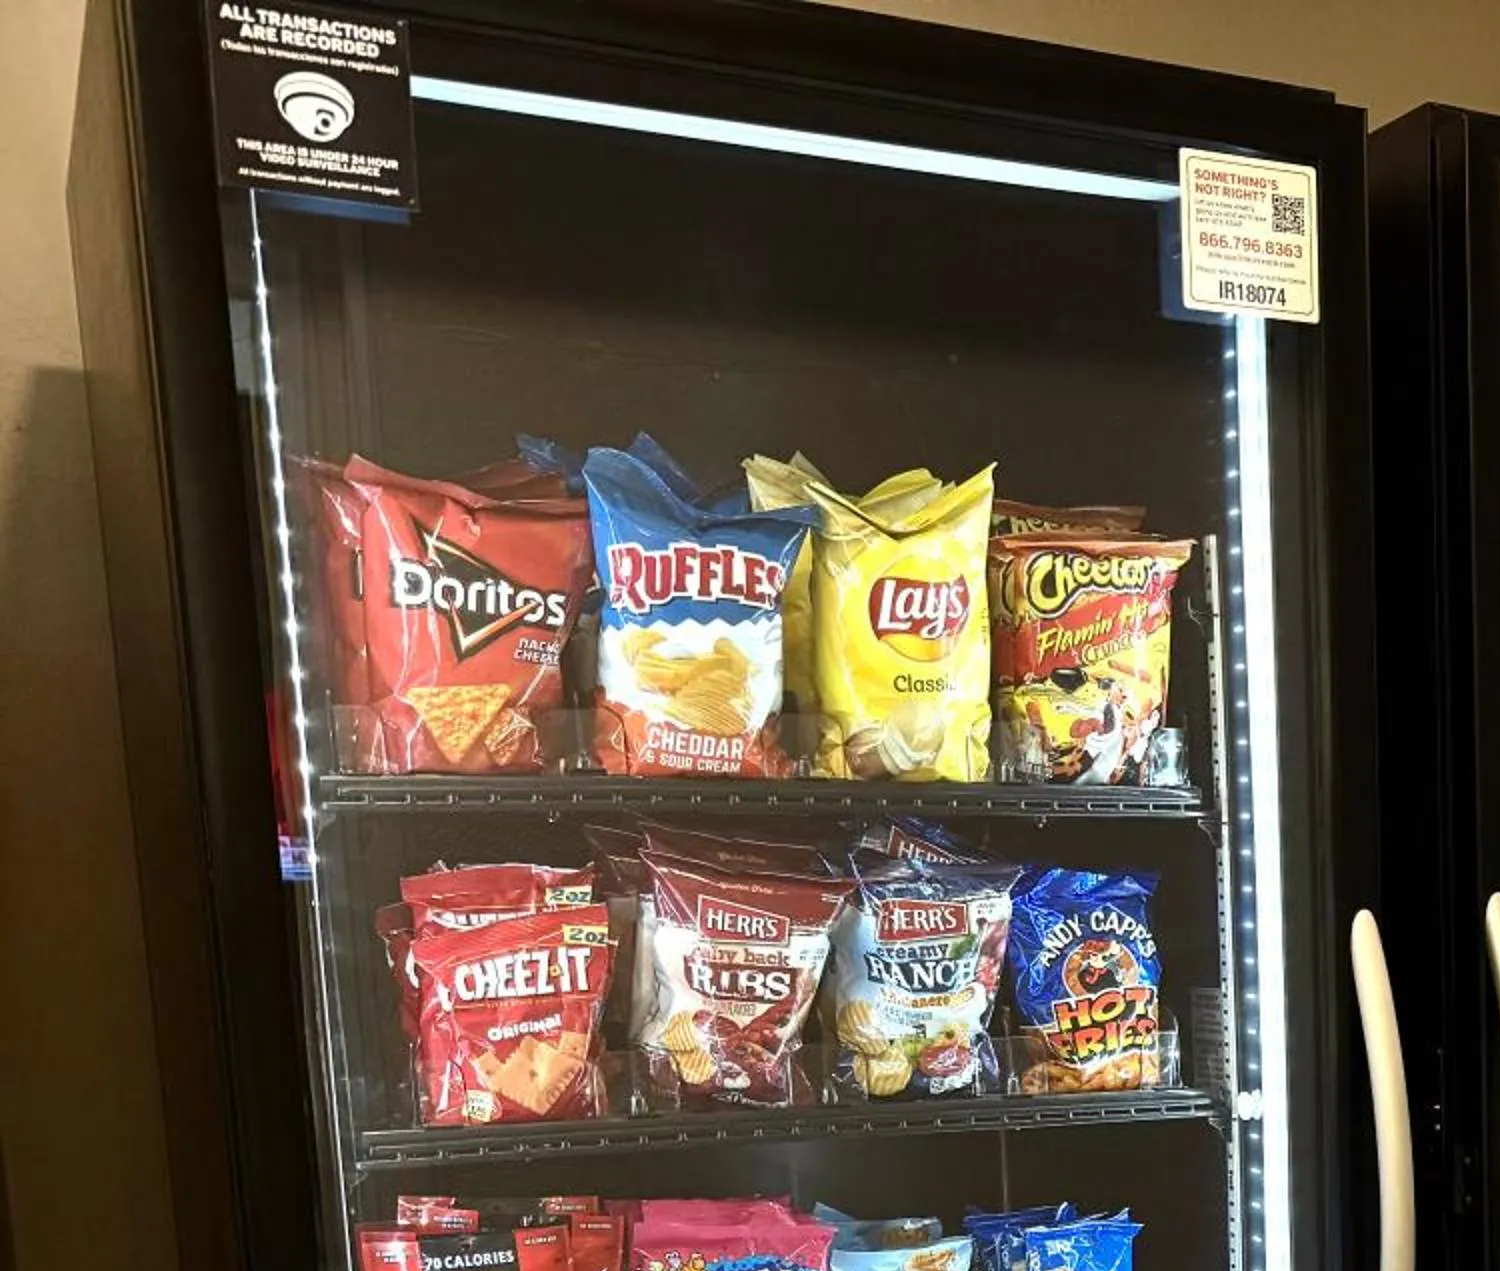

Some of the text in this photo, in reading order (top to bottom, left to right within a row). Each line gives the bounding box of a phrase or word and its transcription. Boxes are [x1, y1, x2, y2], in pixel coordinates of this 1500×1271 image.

[220, 3, 396, 45] ALL TRANSACTIONS
[240, 23, 380, 58] ARE RECORDED
[236, 137, 399, 170] THIS AREA IS UNDER 24 HOUR
[260, 152, 381, 177] VIDEO SURVEILLANCE
[1194, 168, 1279, 191] SOMETHING'S
[1195, 182, 1267, 204] NOT RIGHT?
[1199, 231, 1303, 259] 866.796.8363
[1219, 280, 1286, 306] IR18074
[394, 560, 566, 628] Doritos
[609, 543, 784, 614] RUFFLES
[1027, 552, 1150, 613] Cheetos
[648, 726, 744, 760] CHEDDAR
[659, 750, 693, 768] SOUR
[698, 757, 742, 773] CREAM
[706, 908, 779, 938] HERR'S
[881, 904, 957, 934] HERR'S
[876, 943, 949, 961] creamy
[1039, 910, 1157, 968] ANDY CAPP'S
[743, 948, 790, 966] back
[868, 954, 976, 990] RANCH
[455, 947, 591, 1001] CHEEZ-IT
[689, 962, 791, 1000] RIBS
[1054, 988, 1154, 1033] HOT
[1047, 1017, 1156, 1061] FRIES
[444, 1250, 515, 1270] CALORIES
